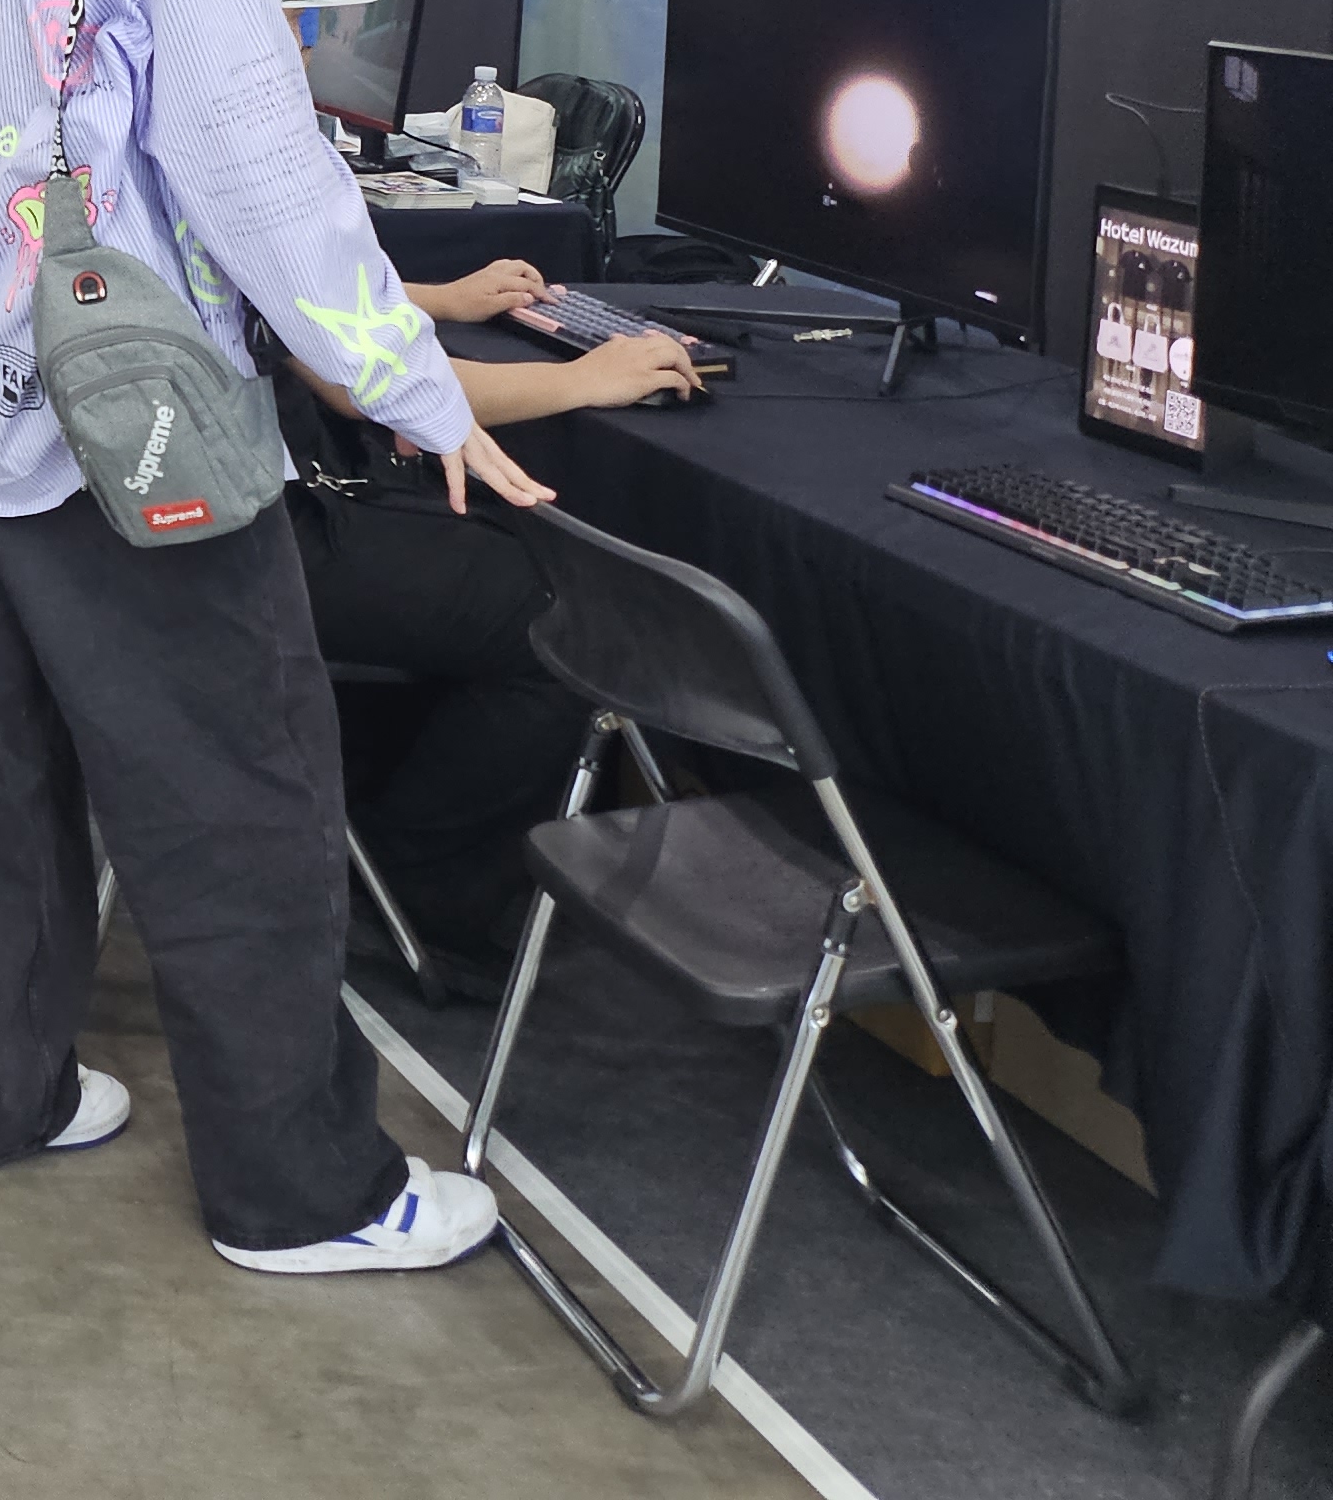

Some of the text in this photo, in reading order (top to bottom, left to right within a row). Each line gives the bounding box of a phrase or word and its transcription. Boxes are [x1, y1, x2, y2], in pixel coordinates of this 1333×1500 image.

[1100, 216, 1145, 245] Hotel
[122, 403, 176, 496] Supreme
[151, 506, 205, 527] Supreme
